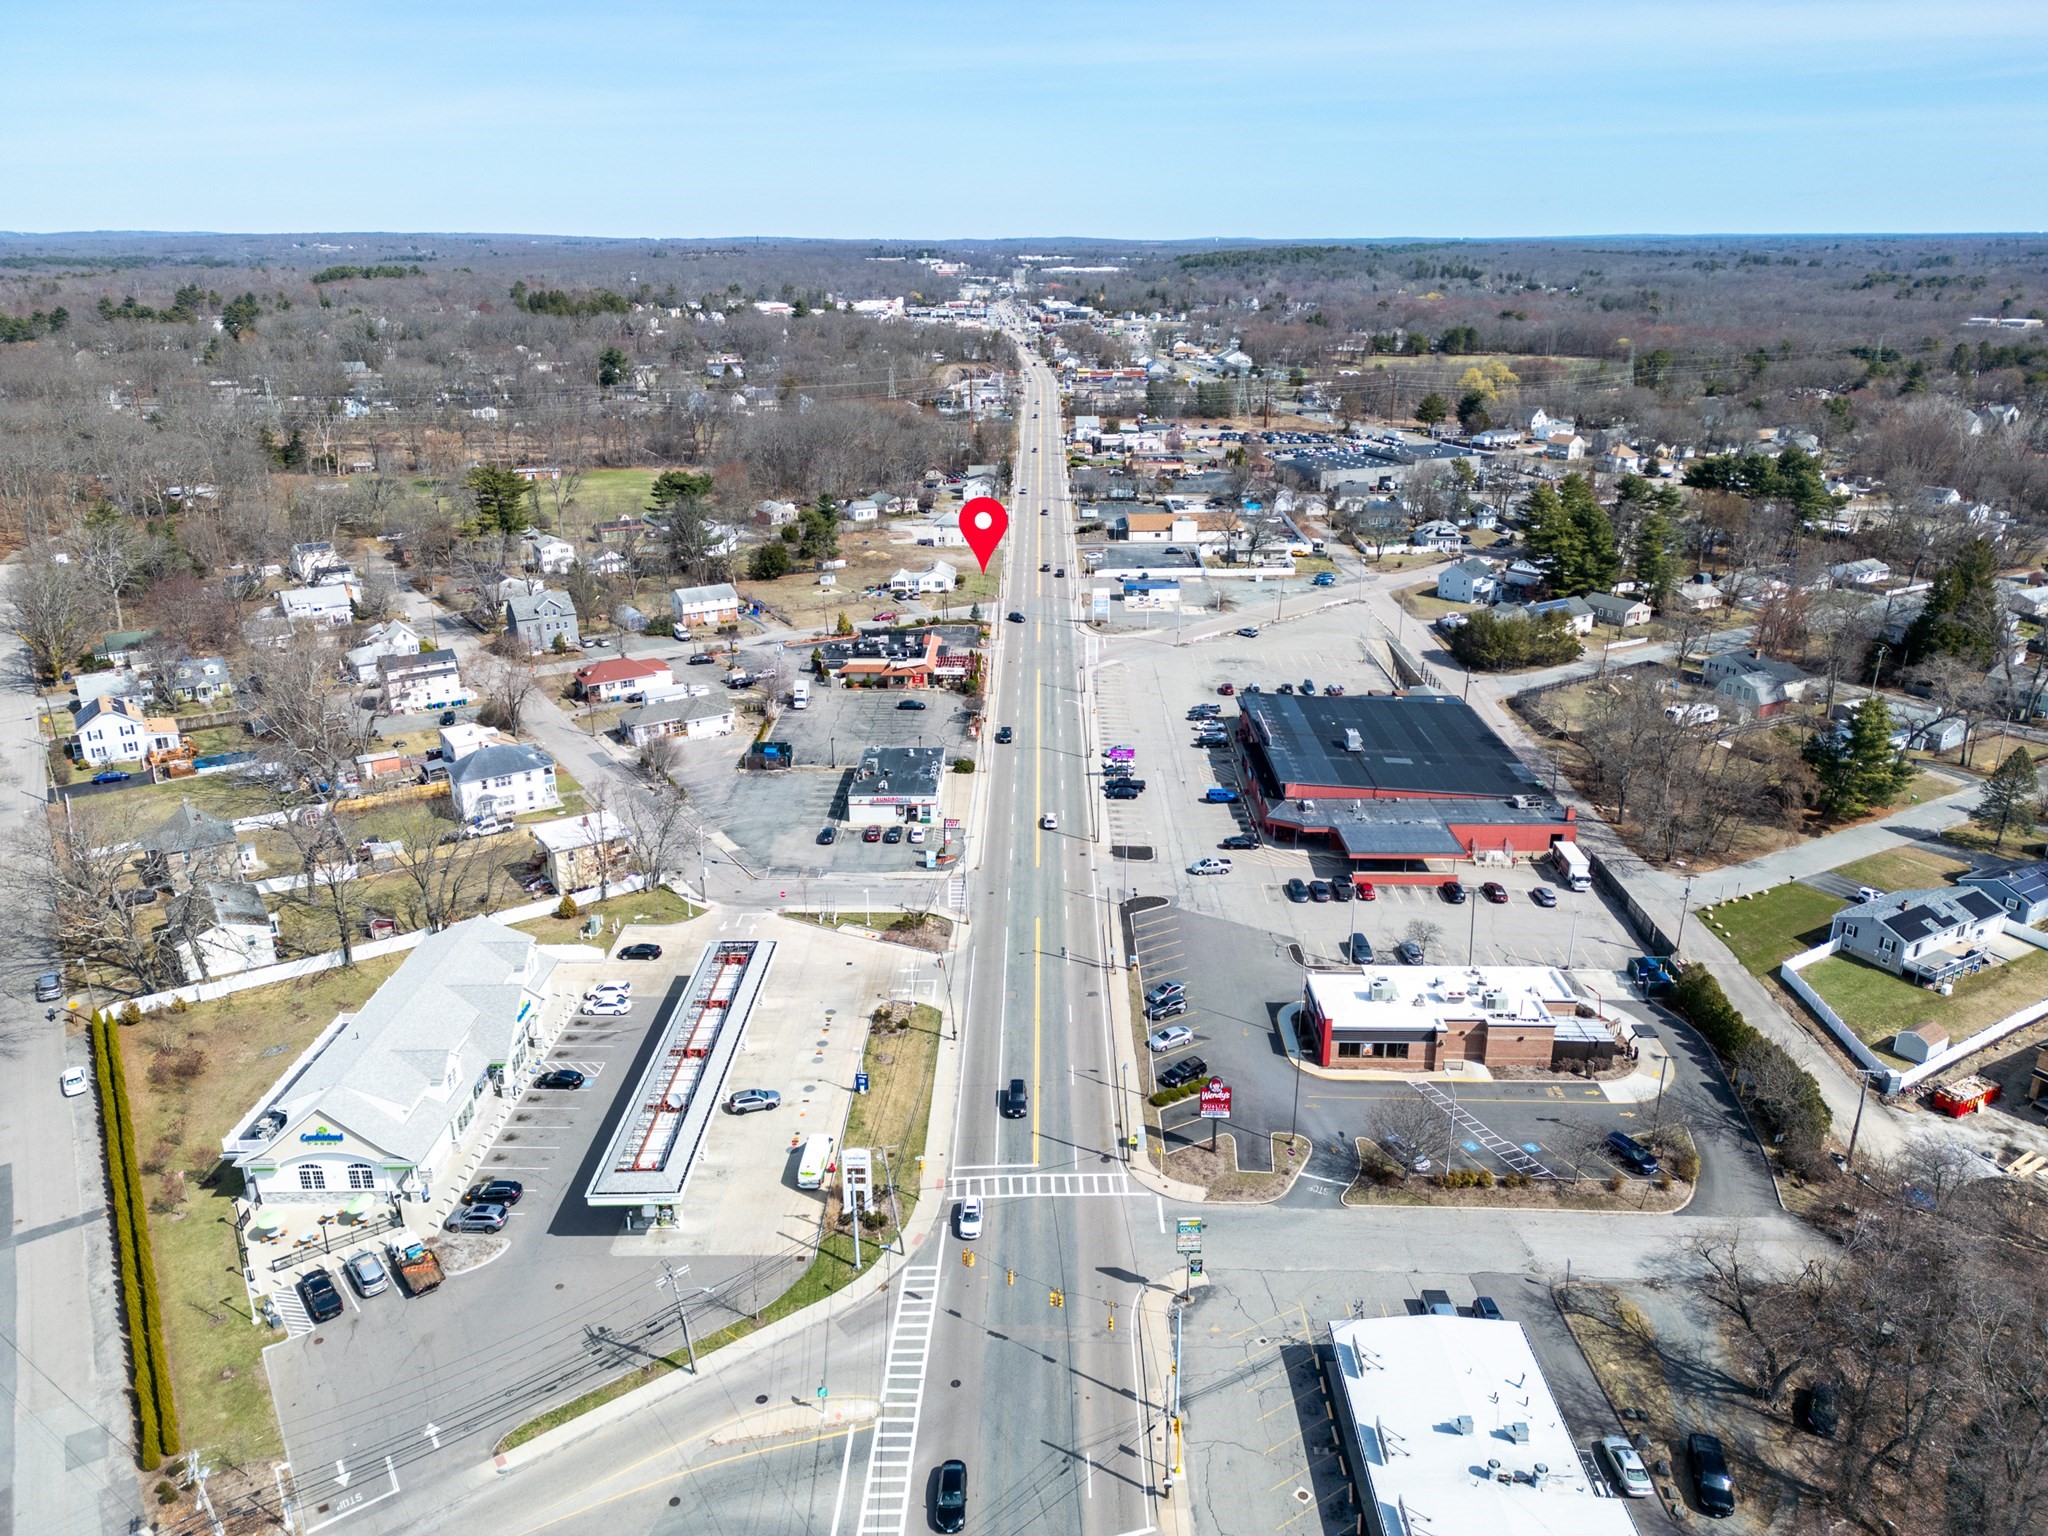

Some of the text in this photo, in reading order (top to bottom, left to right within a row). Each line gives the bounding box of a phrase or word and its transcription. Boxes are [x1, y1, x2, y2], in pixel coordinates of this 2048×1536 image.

[1201, 1090, 1231, 1101] Wendy's
[1307, 1184, 1329, 1196] STOP
[337, 1493, 362, 1510] STOP
